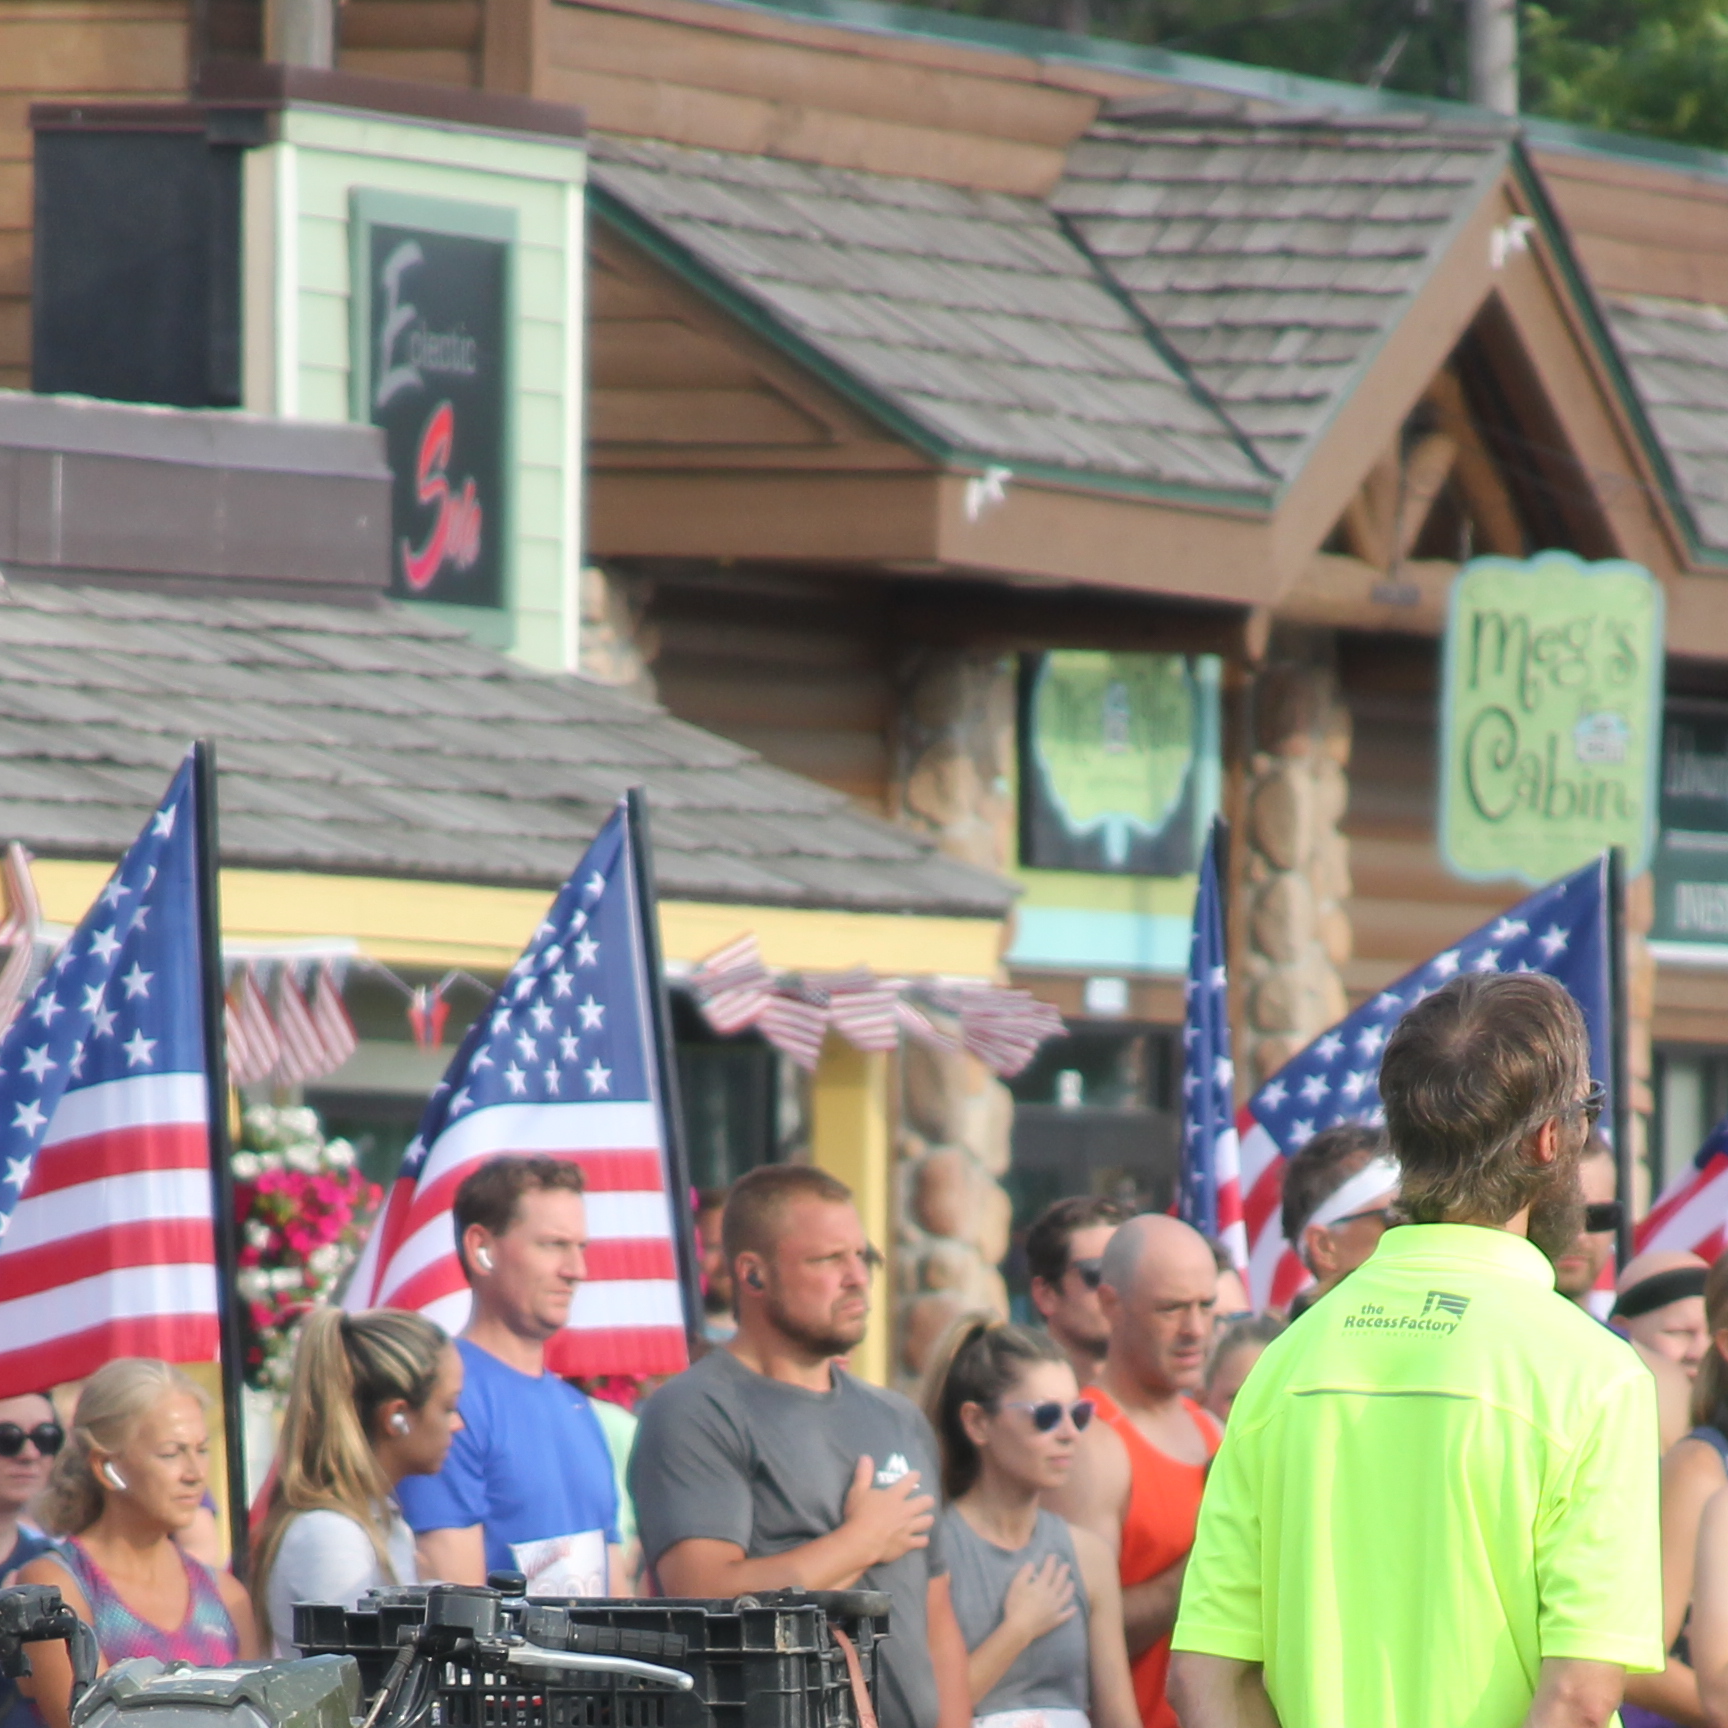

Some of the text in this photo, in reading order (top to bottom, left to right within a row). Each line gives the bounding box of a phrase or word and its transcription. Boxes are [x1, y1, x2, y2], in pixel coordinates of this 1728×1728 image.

[1467, 608, 1638, 713] Meg's
[1463, 705, 1638, 823] Cabin
[1361, 1302, 1384, 1315] the
